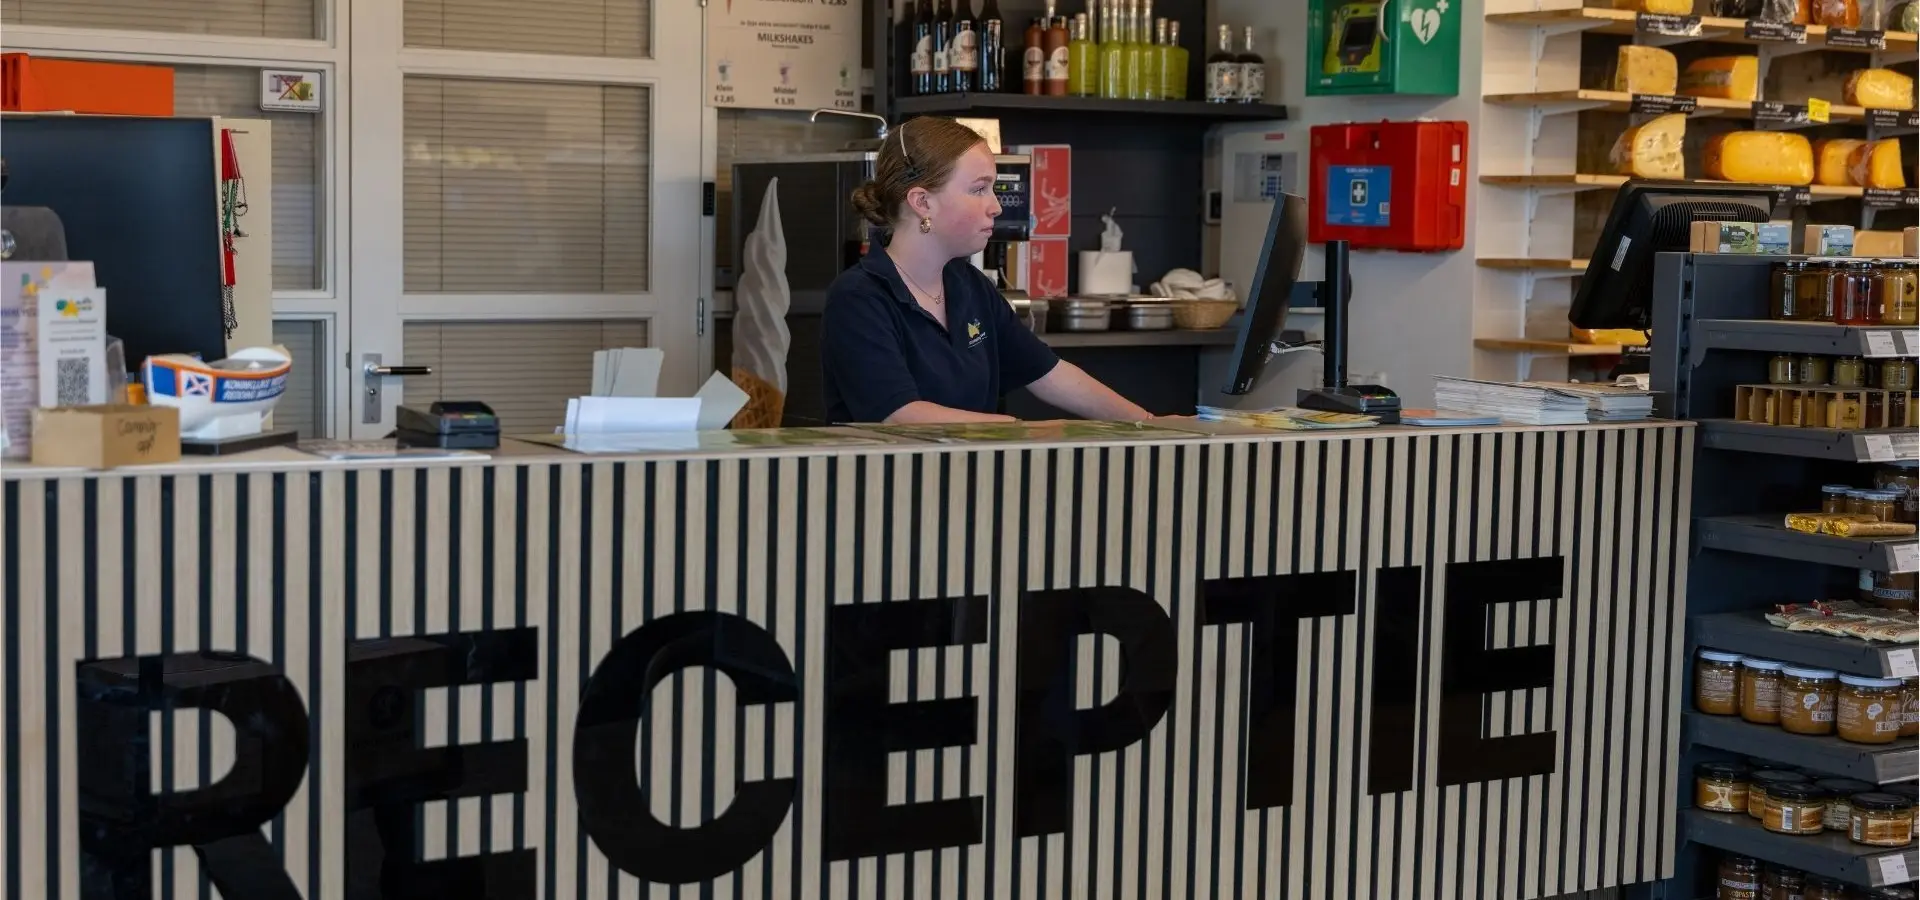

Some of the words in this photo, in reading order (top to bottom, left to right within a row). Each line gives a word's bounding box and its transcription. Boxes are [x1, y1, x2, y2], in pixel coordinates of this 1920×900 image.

[757, 32, 814, 44] MILKSHAKES
[773, 87, 797, 95] Middel
[76, 555, 1564, 900] RECEPTIE
